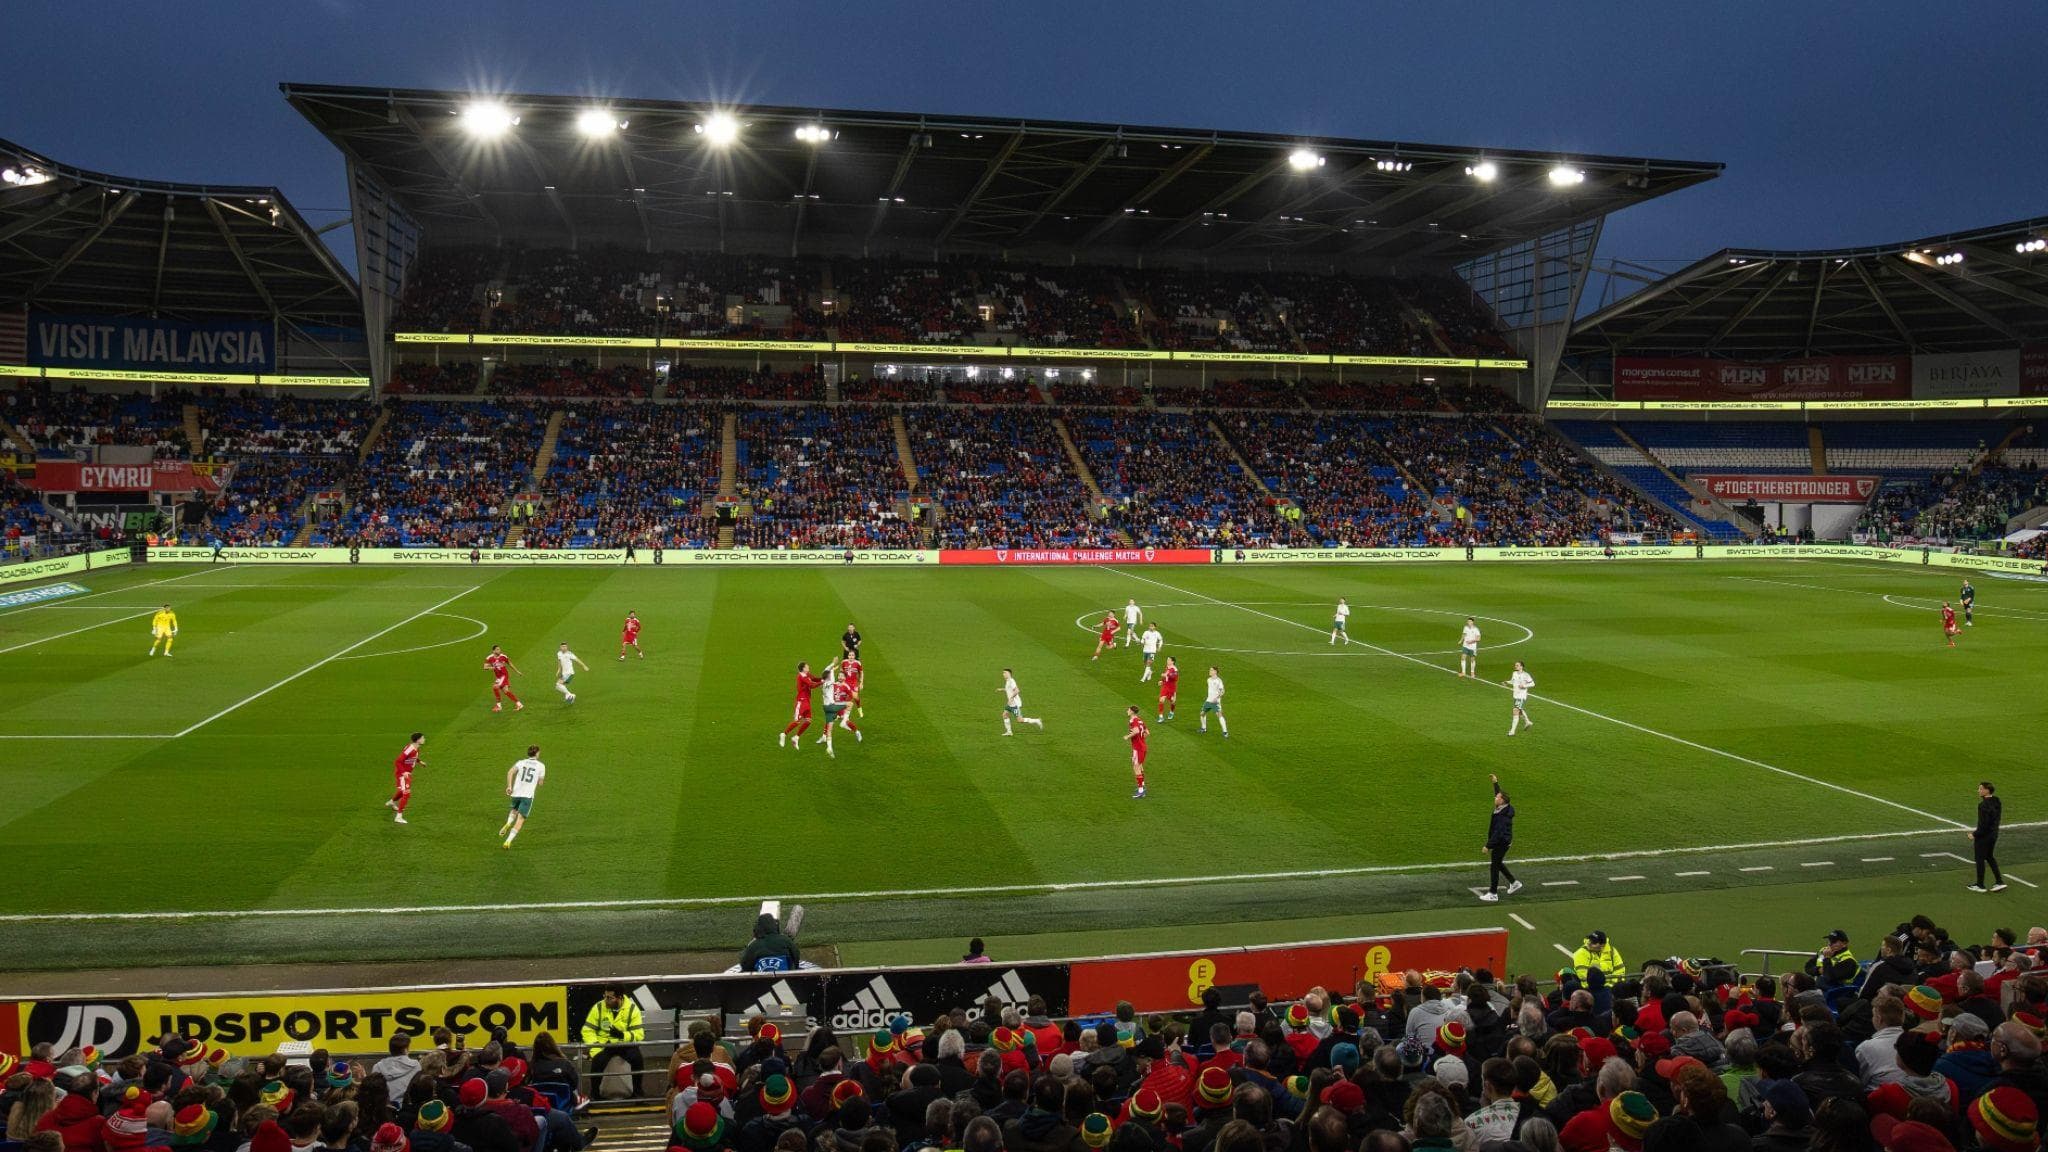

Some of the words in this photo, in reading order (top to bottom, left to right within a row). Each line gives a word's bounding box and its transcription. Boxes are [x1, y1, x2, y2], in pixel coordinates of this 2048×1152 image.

[38, 322, 115, 361] VISIT
[123, 327, 266, 364] MALAYSIA
[1720, 368, 1766, 385] MPN
[1783, 366, 1830, 383] MPN
[1848, 364, 1896, 382] MPN
[81, 466, 152, 488] CYMRU
[1713, 480, 1850, 496] #TOGETHERSTRONGER
[393, 552, 450, 560] SWITCH
[1014, 552, 1070, 561] INTERNATIONAL
[1073, 552, 1113, 561] CHALLENGE
[1116, 552, 1140, 561] MATCH
[1641, 549, 1674, 557] TODAY
[1798, 548, 1873, 556] BROADBAND
[1874, 551, 1903, 559] TODAY
[0, 565, 44, 579] ROADBAND
[45, 561, 70, 572] TODAY
[1950, 557, 1988, 567] SWITCH
[1991, 560, 2004, 568] TO
[2005, 561, 2019, 569] EE
[520, 766, 536, 784] 15
[832, 1008, 914, 1030] adidas
[53, 1004, 128, 1060] JD
[147, 1000, 558, 1046] JDSPORTS.COM
